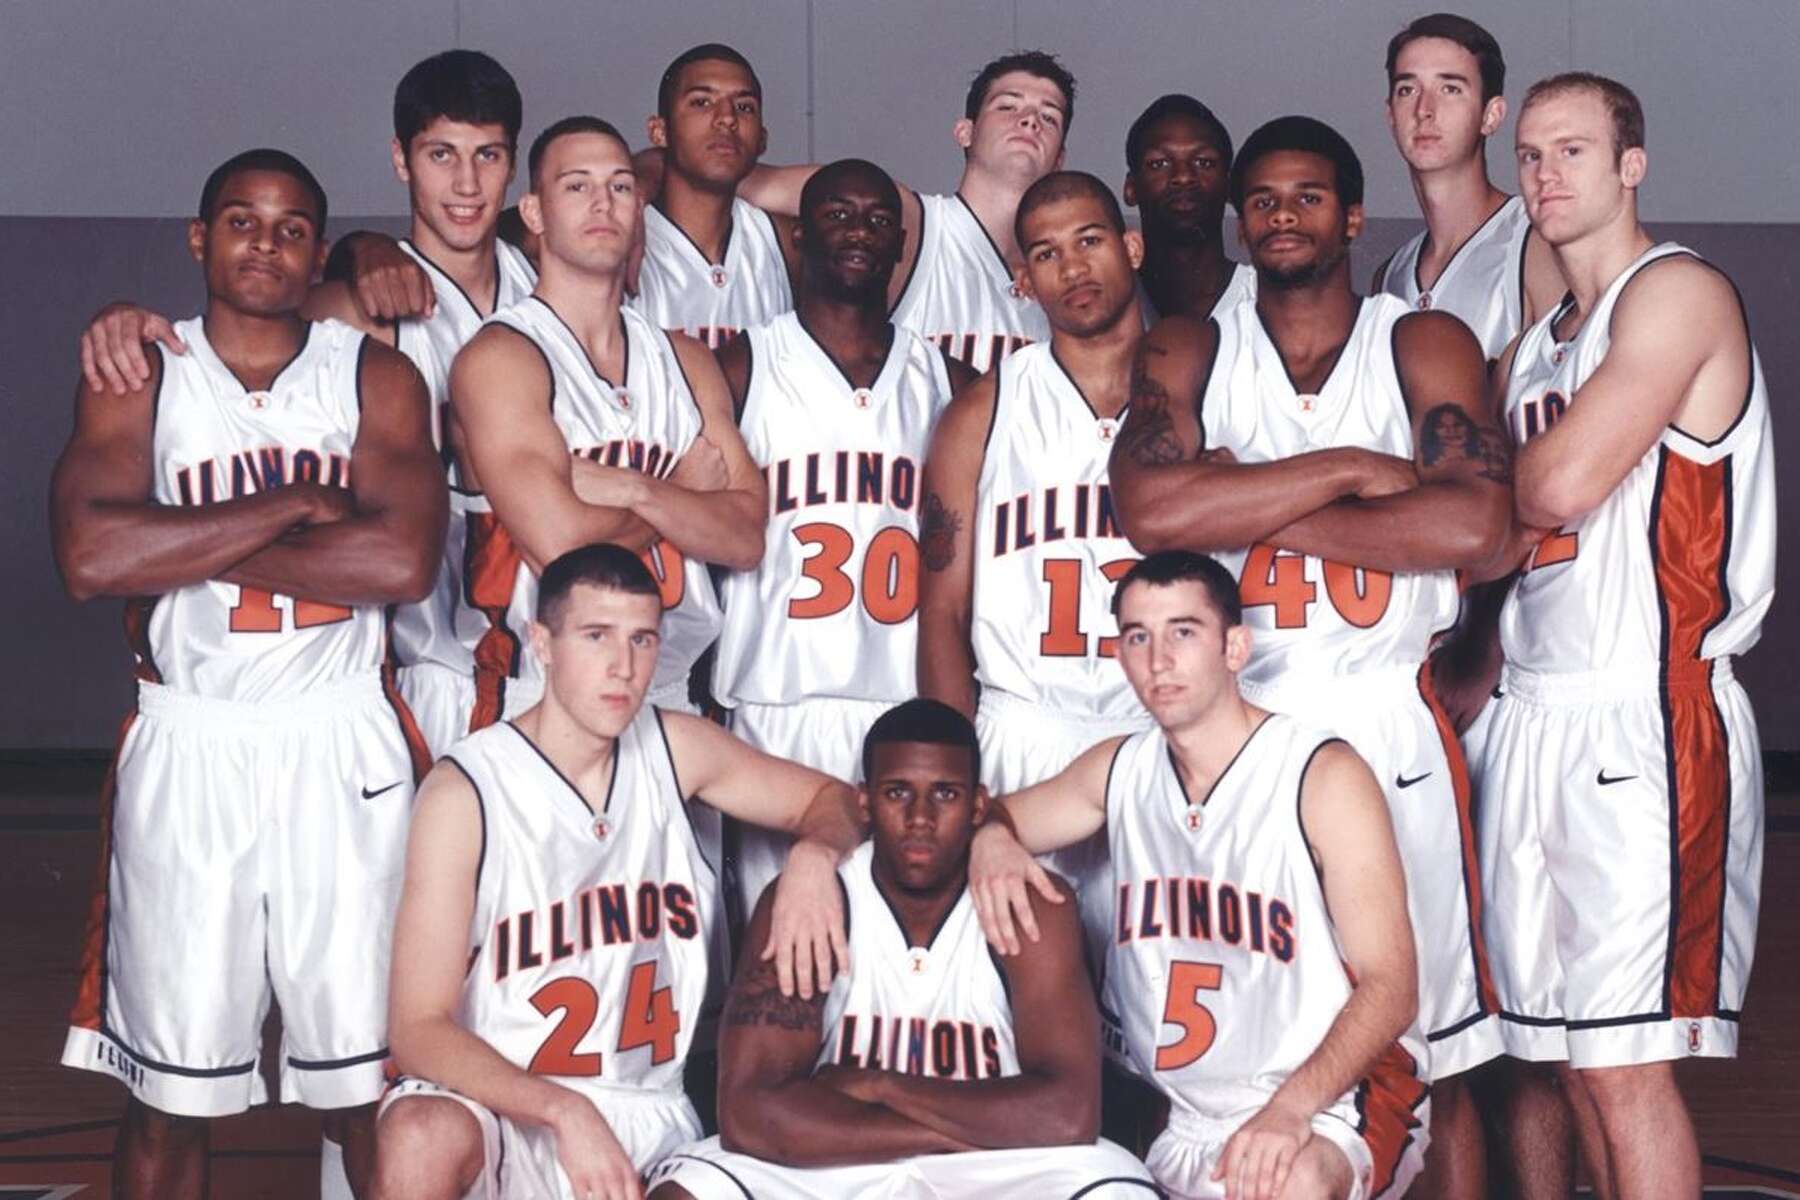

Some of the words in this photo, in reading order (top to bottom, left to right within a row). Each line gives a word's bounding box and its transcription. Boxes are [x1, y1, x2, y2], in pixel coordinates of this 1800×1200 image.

[761, 450, 925, 517] LLINO
[993, 484, 1127, 558] ILLIN
[788, 522, 919, 625] 30
[1239, 542, 1393, 629] 40
[1117, 877, 1295, 964] LLINOIS
[528, 960, 681, 1078] 24
[839, 1015, 1001, 1080] LLINOIS
[1155, 960, 1223, 1071] 5
